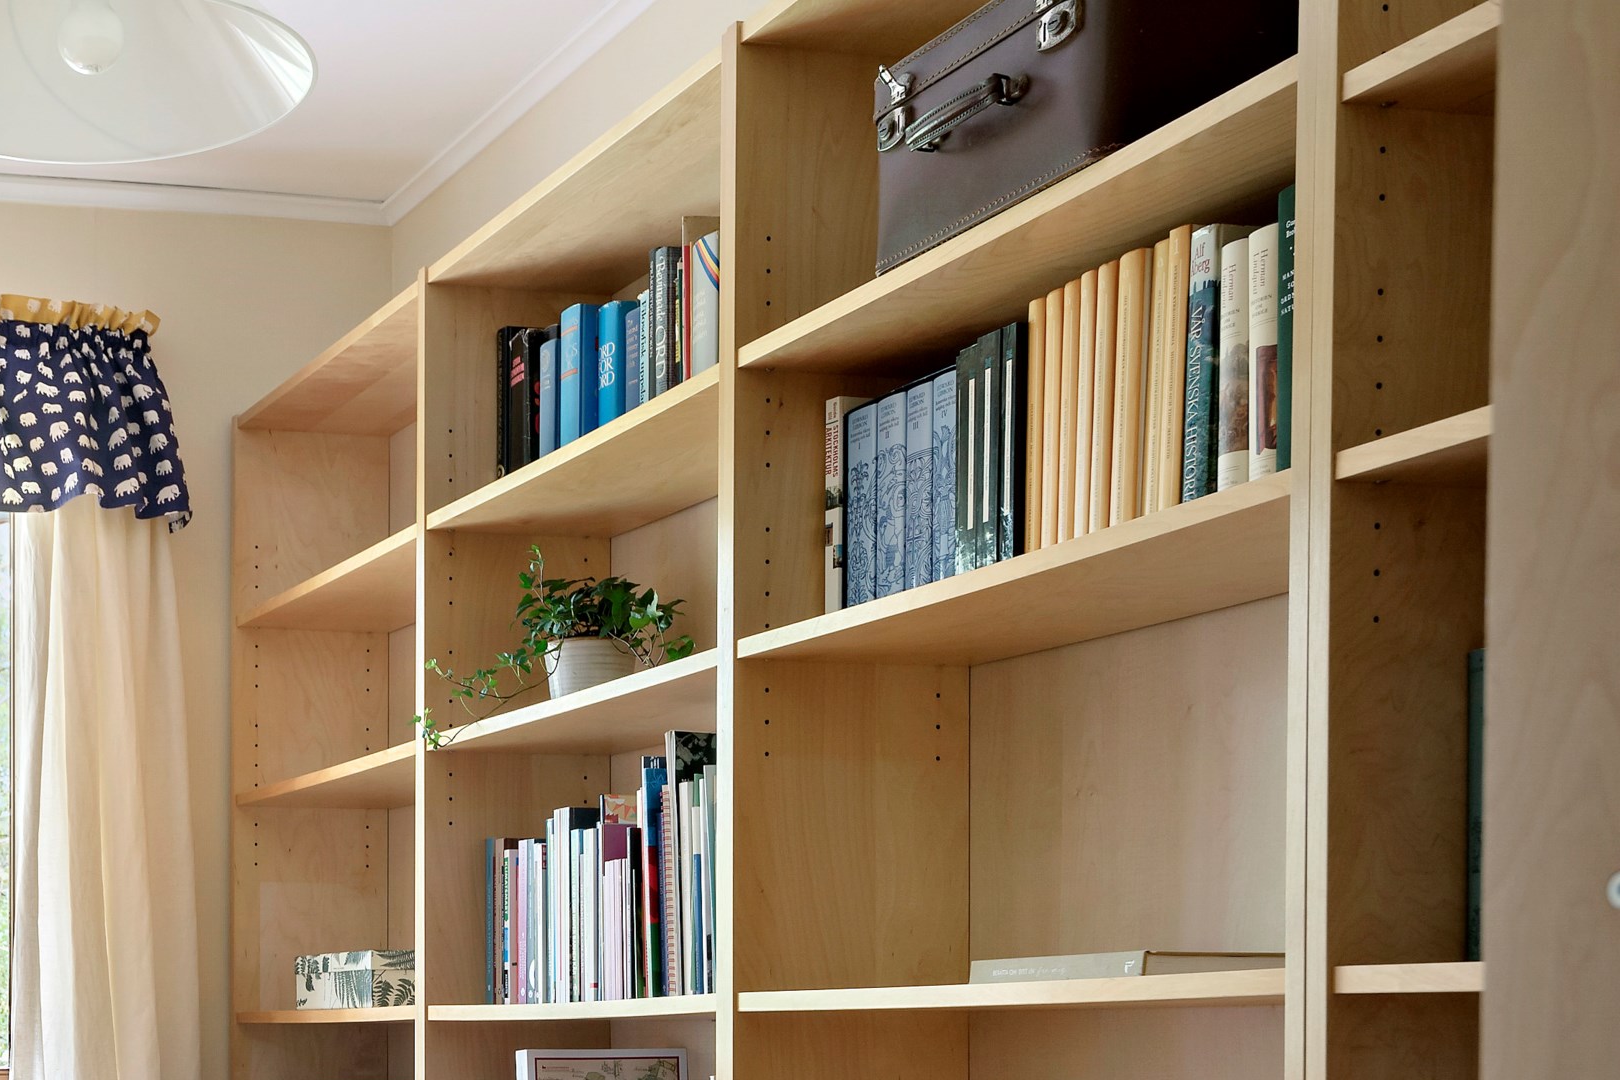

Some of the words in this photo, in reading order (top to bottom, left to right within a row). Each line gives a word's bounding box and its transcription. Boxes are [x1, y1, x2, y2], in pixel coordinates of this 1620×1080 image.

[1194, 242, 1206, 260] Alf
[1260, 248, 1268, 287] Herman
[656, 256, 666, 322] Bevingade
[640, 300, 648, 358] Filosofisk
[1190, 306, 1205, 341] VÅR
[599, 357, 614, 370] OR
[656, 325, 667, 379] ORD
[640, 361, 648, 404] uppsla
[1186, 345, 1201, 422] SVENSKA
[1184, 428, 1198, 501] HISTORI
